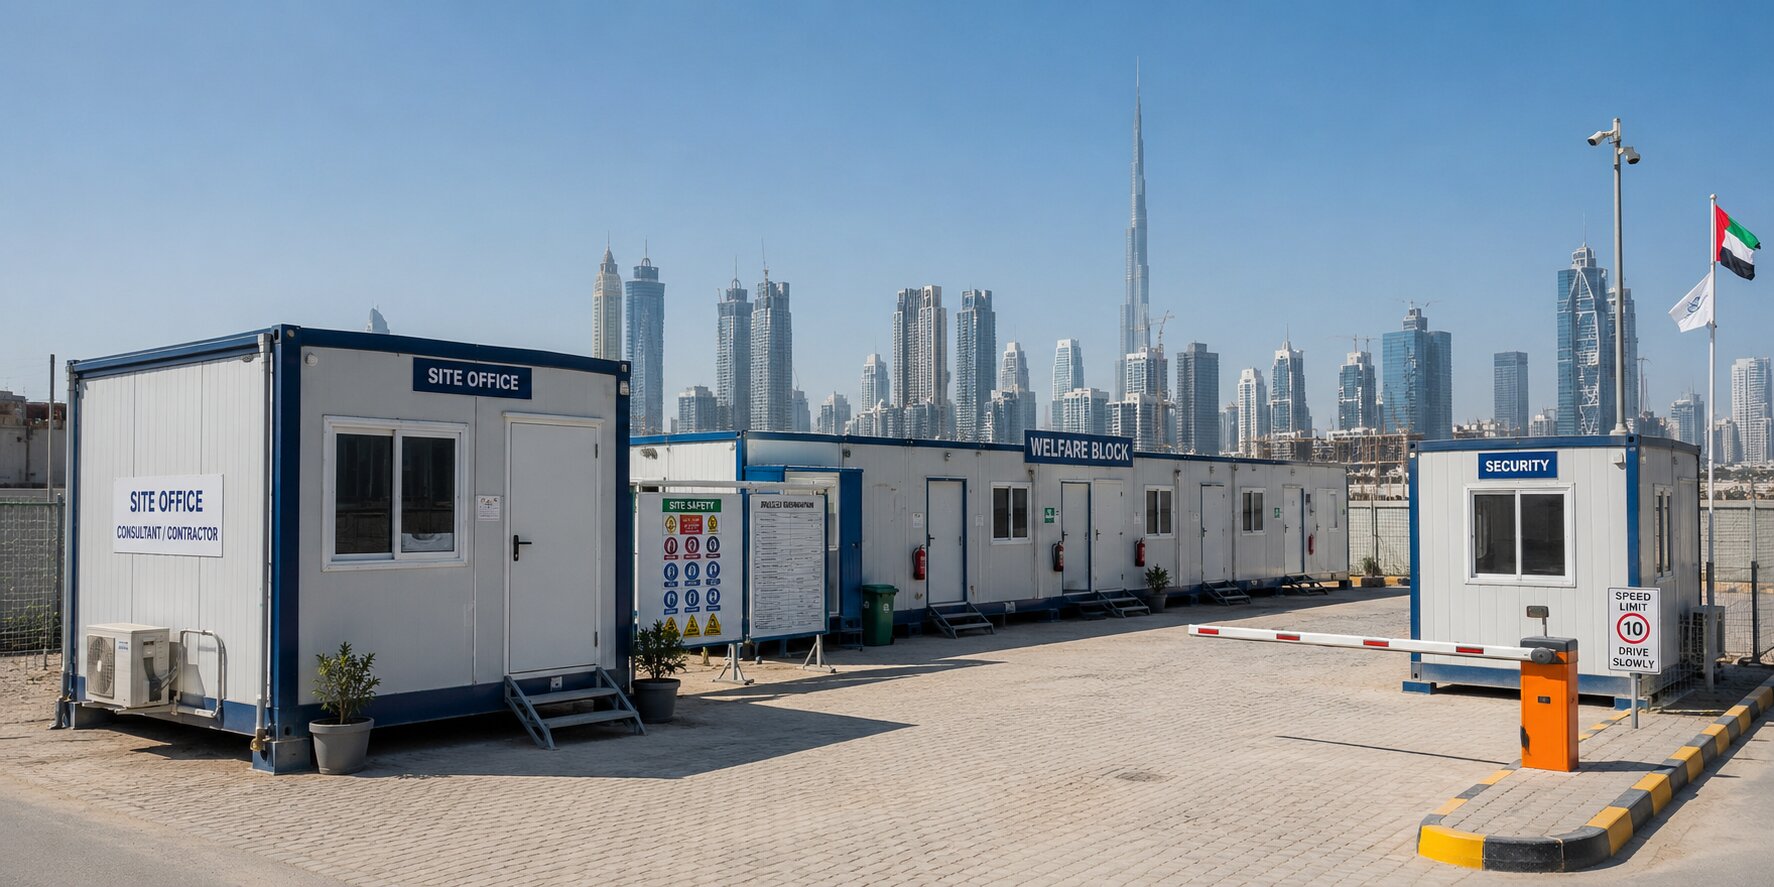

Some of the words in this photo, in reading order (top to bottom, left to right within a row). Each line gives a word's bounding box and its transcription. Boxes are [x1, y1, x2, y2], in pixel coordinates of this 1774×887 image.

[428, 367, 463, 386] SITE
[467, 371, 519, 391] OFFICE
[1030, 437, 1088, 459] WELFARE
[1091, 441, 1129, 461] BLOCK
[1485, 459, 1550, 472] SECURITY
[130, 490, 155, 512] SITE
[159, 490, 203, 512] OFFICE
[669, 501, 685, 510] SITE
[687, 501, 715, 510] SAFETY
[117, 525, 161, 540] CONSULTANT
[167, 526, 218, 541] CONTRACTOR
[1615, 591, 1651, 601] SPEED
[1619, 603, 1648, 612] LIMIT
[1623, 621, 1643, 636] 10
[1618, 646, 1649, 657] DRIVE
[1613, 657, 1655, 669] SLOWLY
